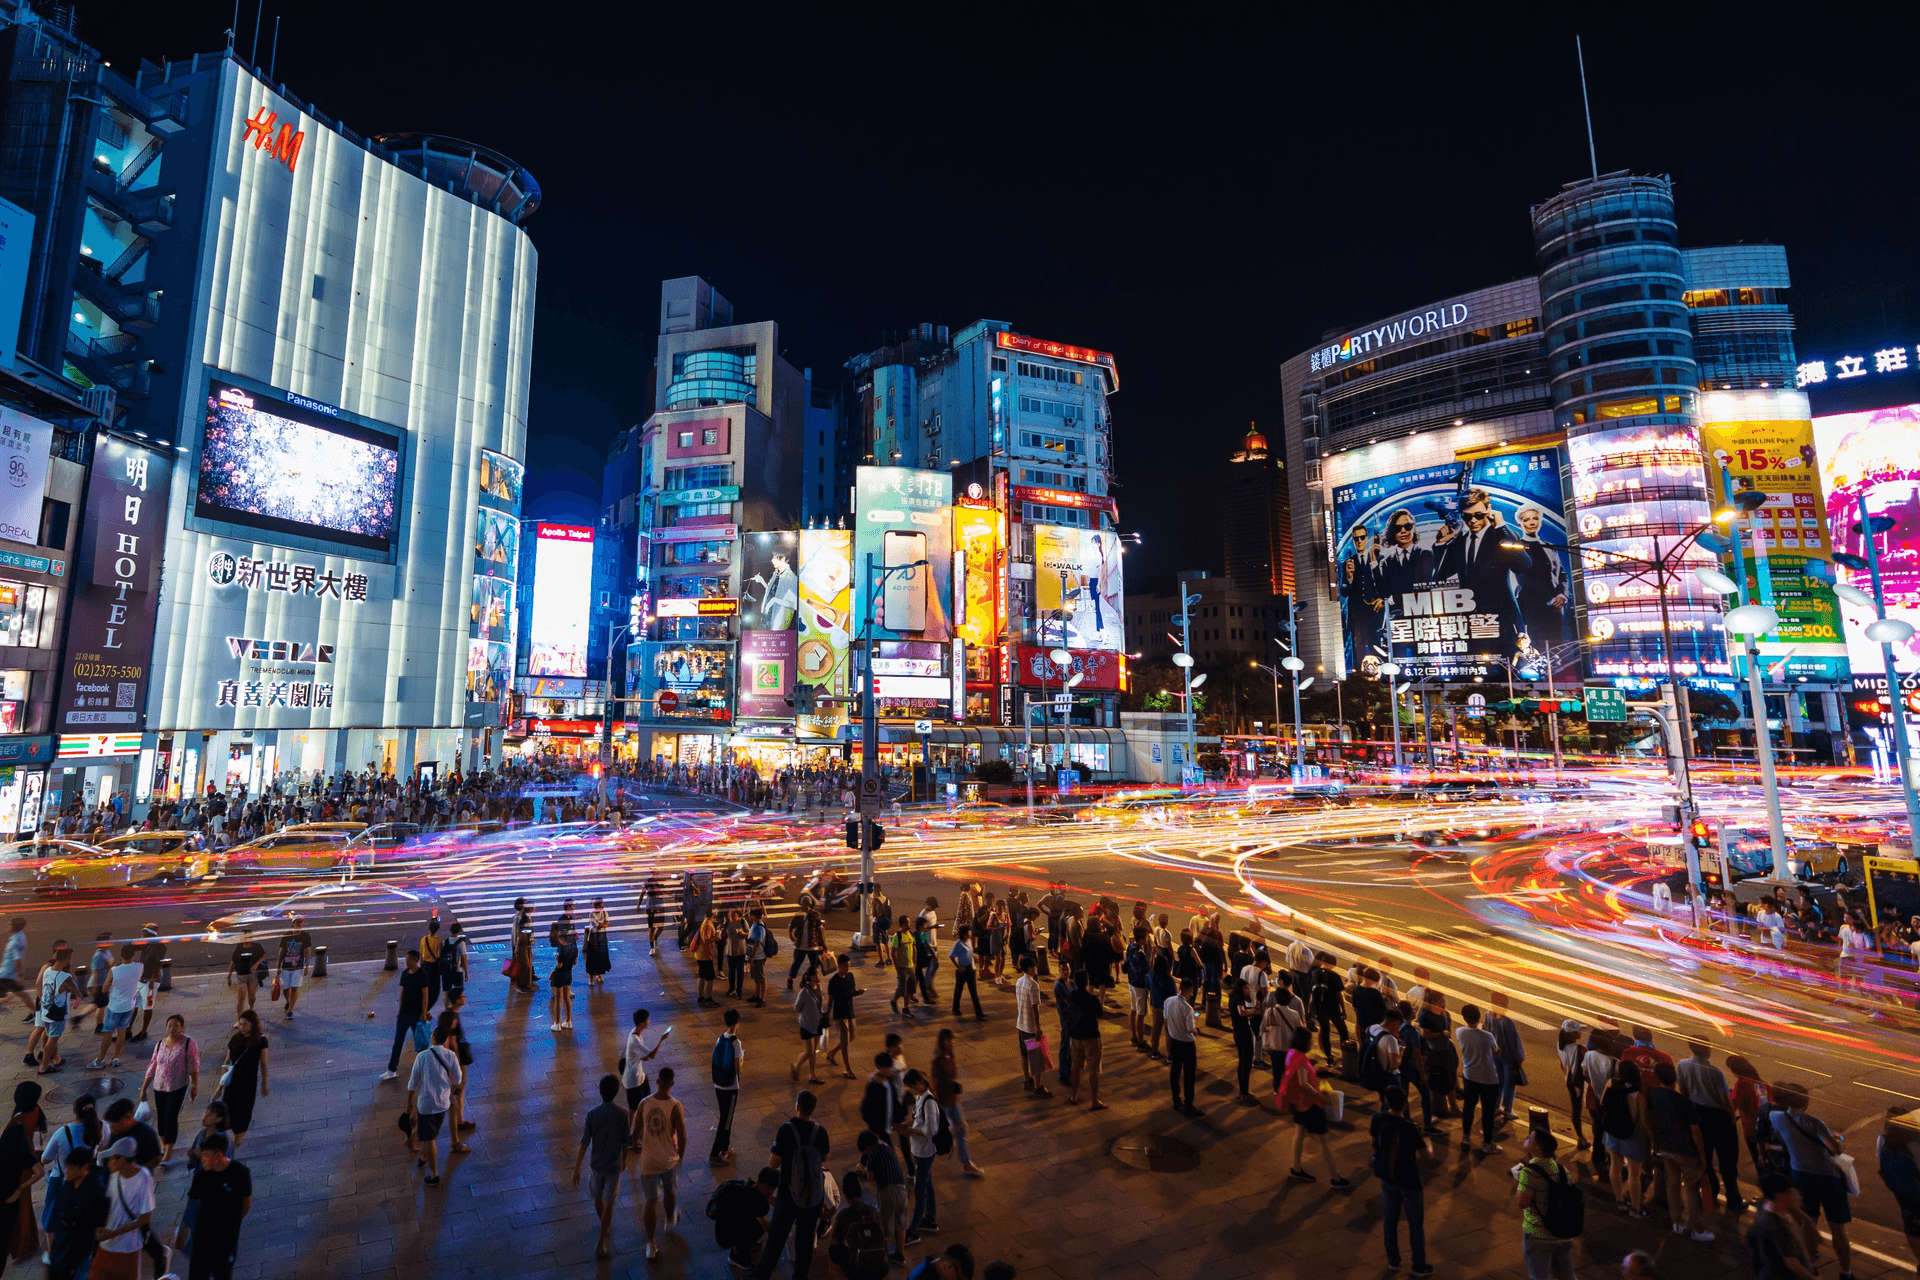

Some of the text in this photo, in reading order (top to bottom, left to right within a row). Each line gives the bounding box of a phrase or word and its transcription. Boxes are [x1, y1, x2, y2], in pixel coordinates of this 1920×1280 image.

[243, 106, 304, 172] H&M
[1011, 336, 1031, 346] Diary
[1043, 344, 1064, 355] Taipei
[1796, 346, 1920, 388] 德立莊
[287, 392, 338, 416] Panasonic
[1735, 449, 1786, 470] 15%
[124, 456, 148, 526] 明日
[541, 527, 591, 540] Apollo Taipei
[103, 532, 139, 650] HOTEL
[238, 556, 368, 602] 新世界大樓
[1402, 589, 1476, 616] MIB
[1390, 613, 1500, 643] 星際戰警
[73, 662, 142, 679] (02)2375-5500
[76, 682, 110, 692] facebook
[218, 680, 333, 708] 真善美劇院
[71, 713, 107, 722] 明日大飯店
